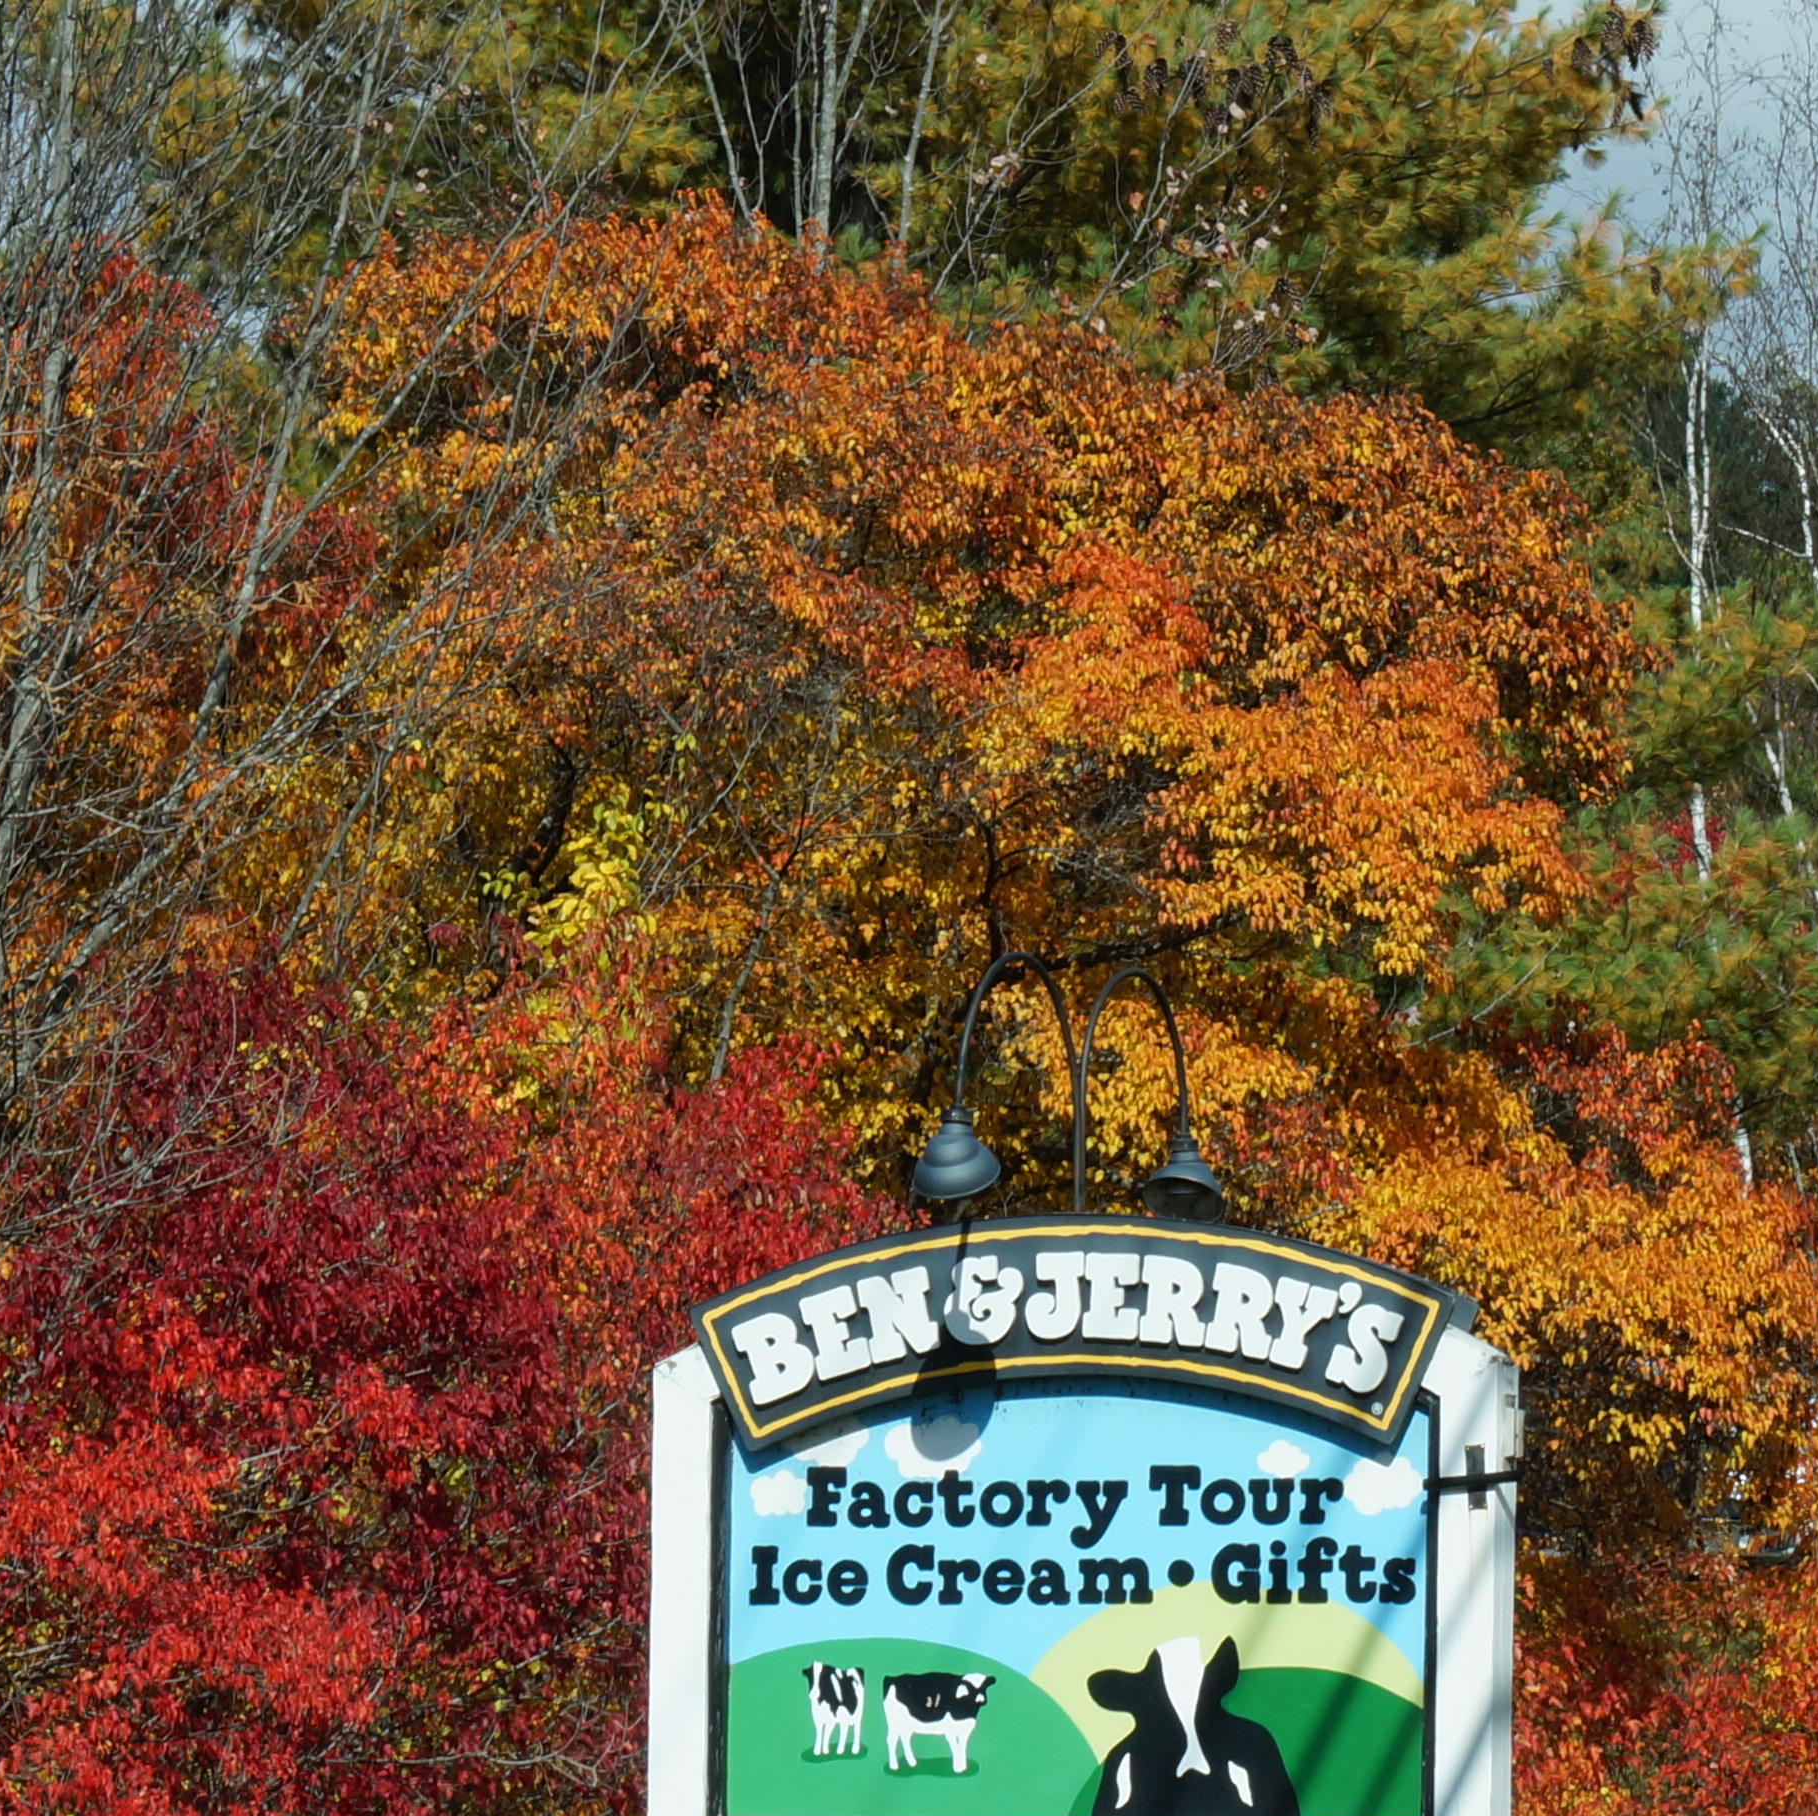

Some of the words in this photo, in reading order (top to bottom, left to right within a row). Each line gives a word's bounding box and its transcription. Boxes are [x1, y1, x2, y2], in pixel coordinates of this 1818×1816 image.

[731, 1266, 940, 1406] BEN
[944, 1256, 1023, 1343] &
[1024, 1251, 1405, 1394] JERRY'S
[805, 1466, 1127, 1548] Factory
[1149, 1464, 1344, 1527] Tour
[748, 1546, 867, 1605] Ice
[886, 1544, 1154, 1605] Cream
[1212, 1538, 1417, 1605] Gifts
